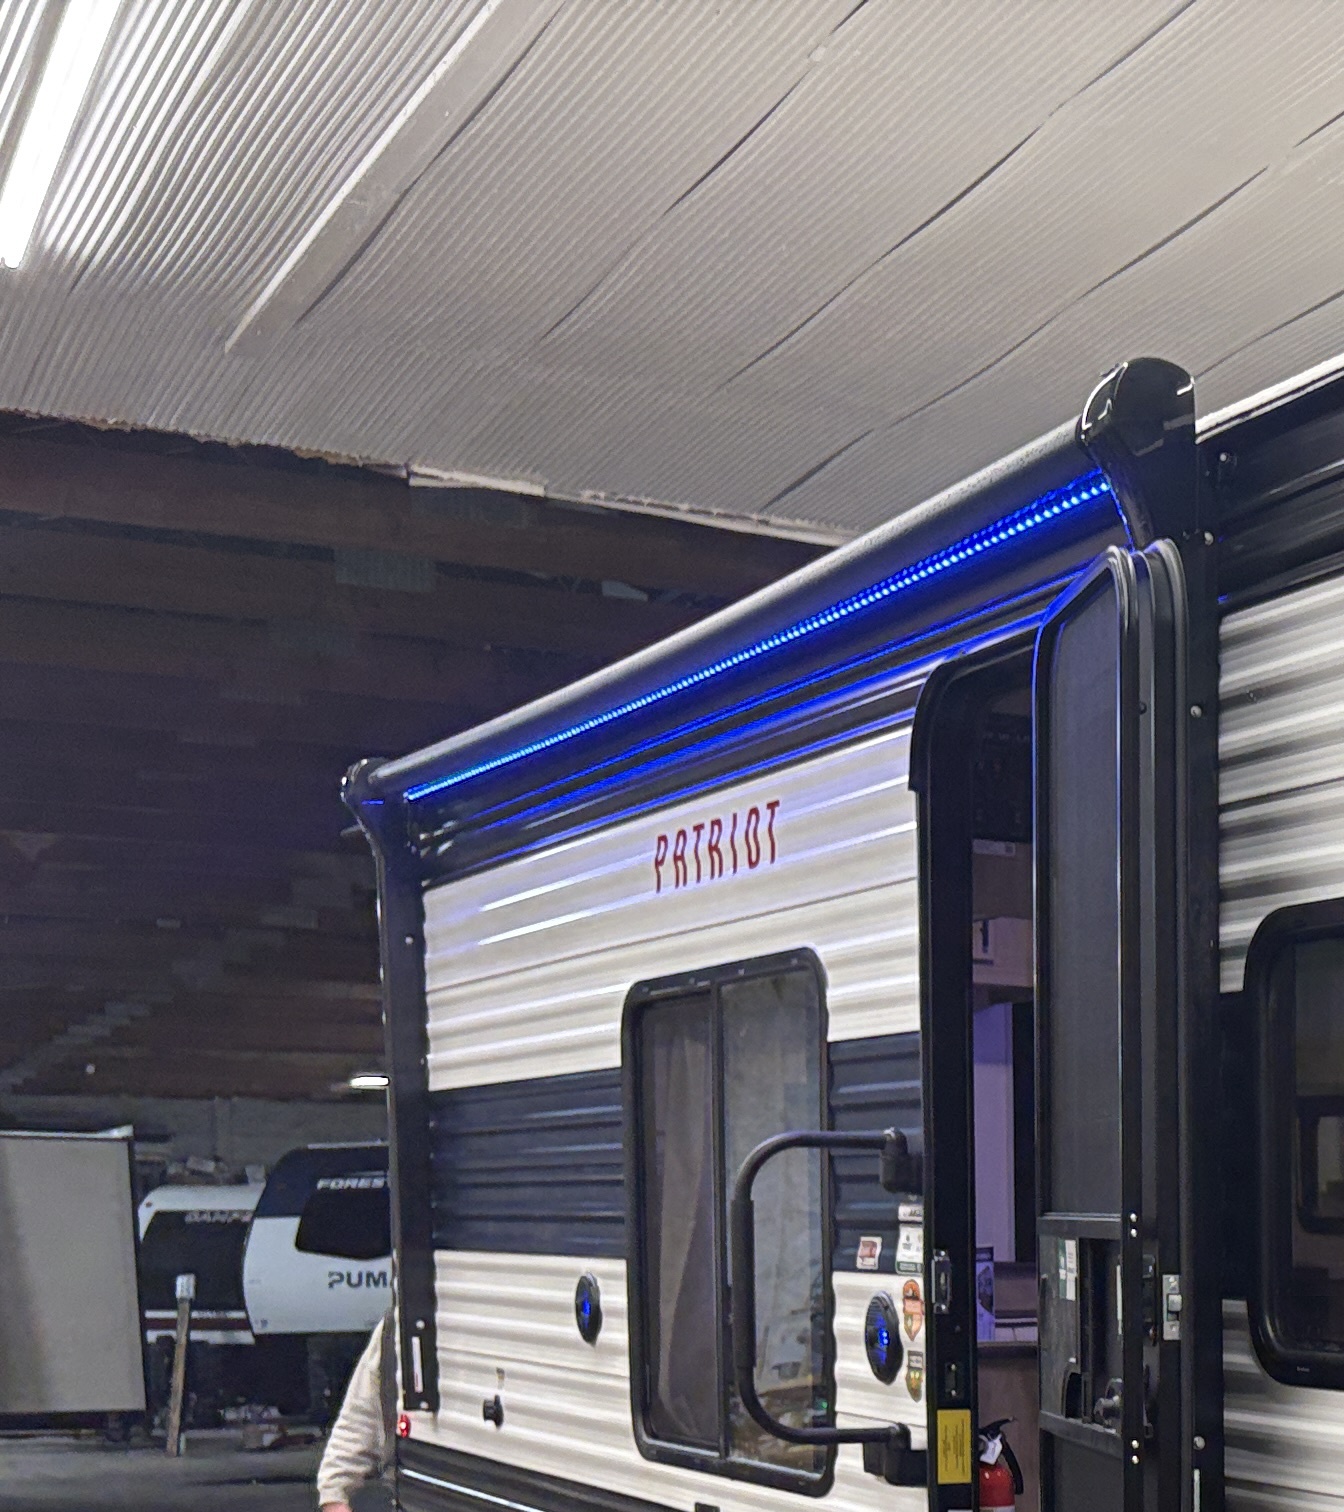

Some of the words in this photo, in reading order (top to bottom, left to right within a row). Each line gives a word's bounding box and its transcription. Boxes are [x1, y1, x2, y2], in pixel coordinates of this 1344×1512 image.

[654, 799, 781, 894] PATRIOT
[316, 1177, 392, 1191] FORES
[327, 1271, 393, 1290] PUM
